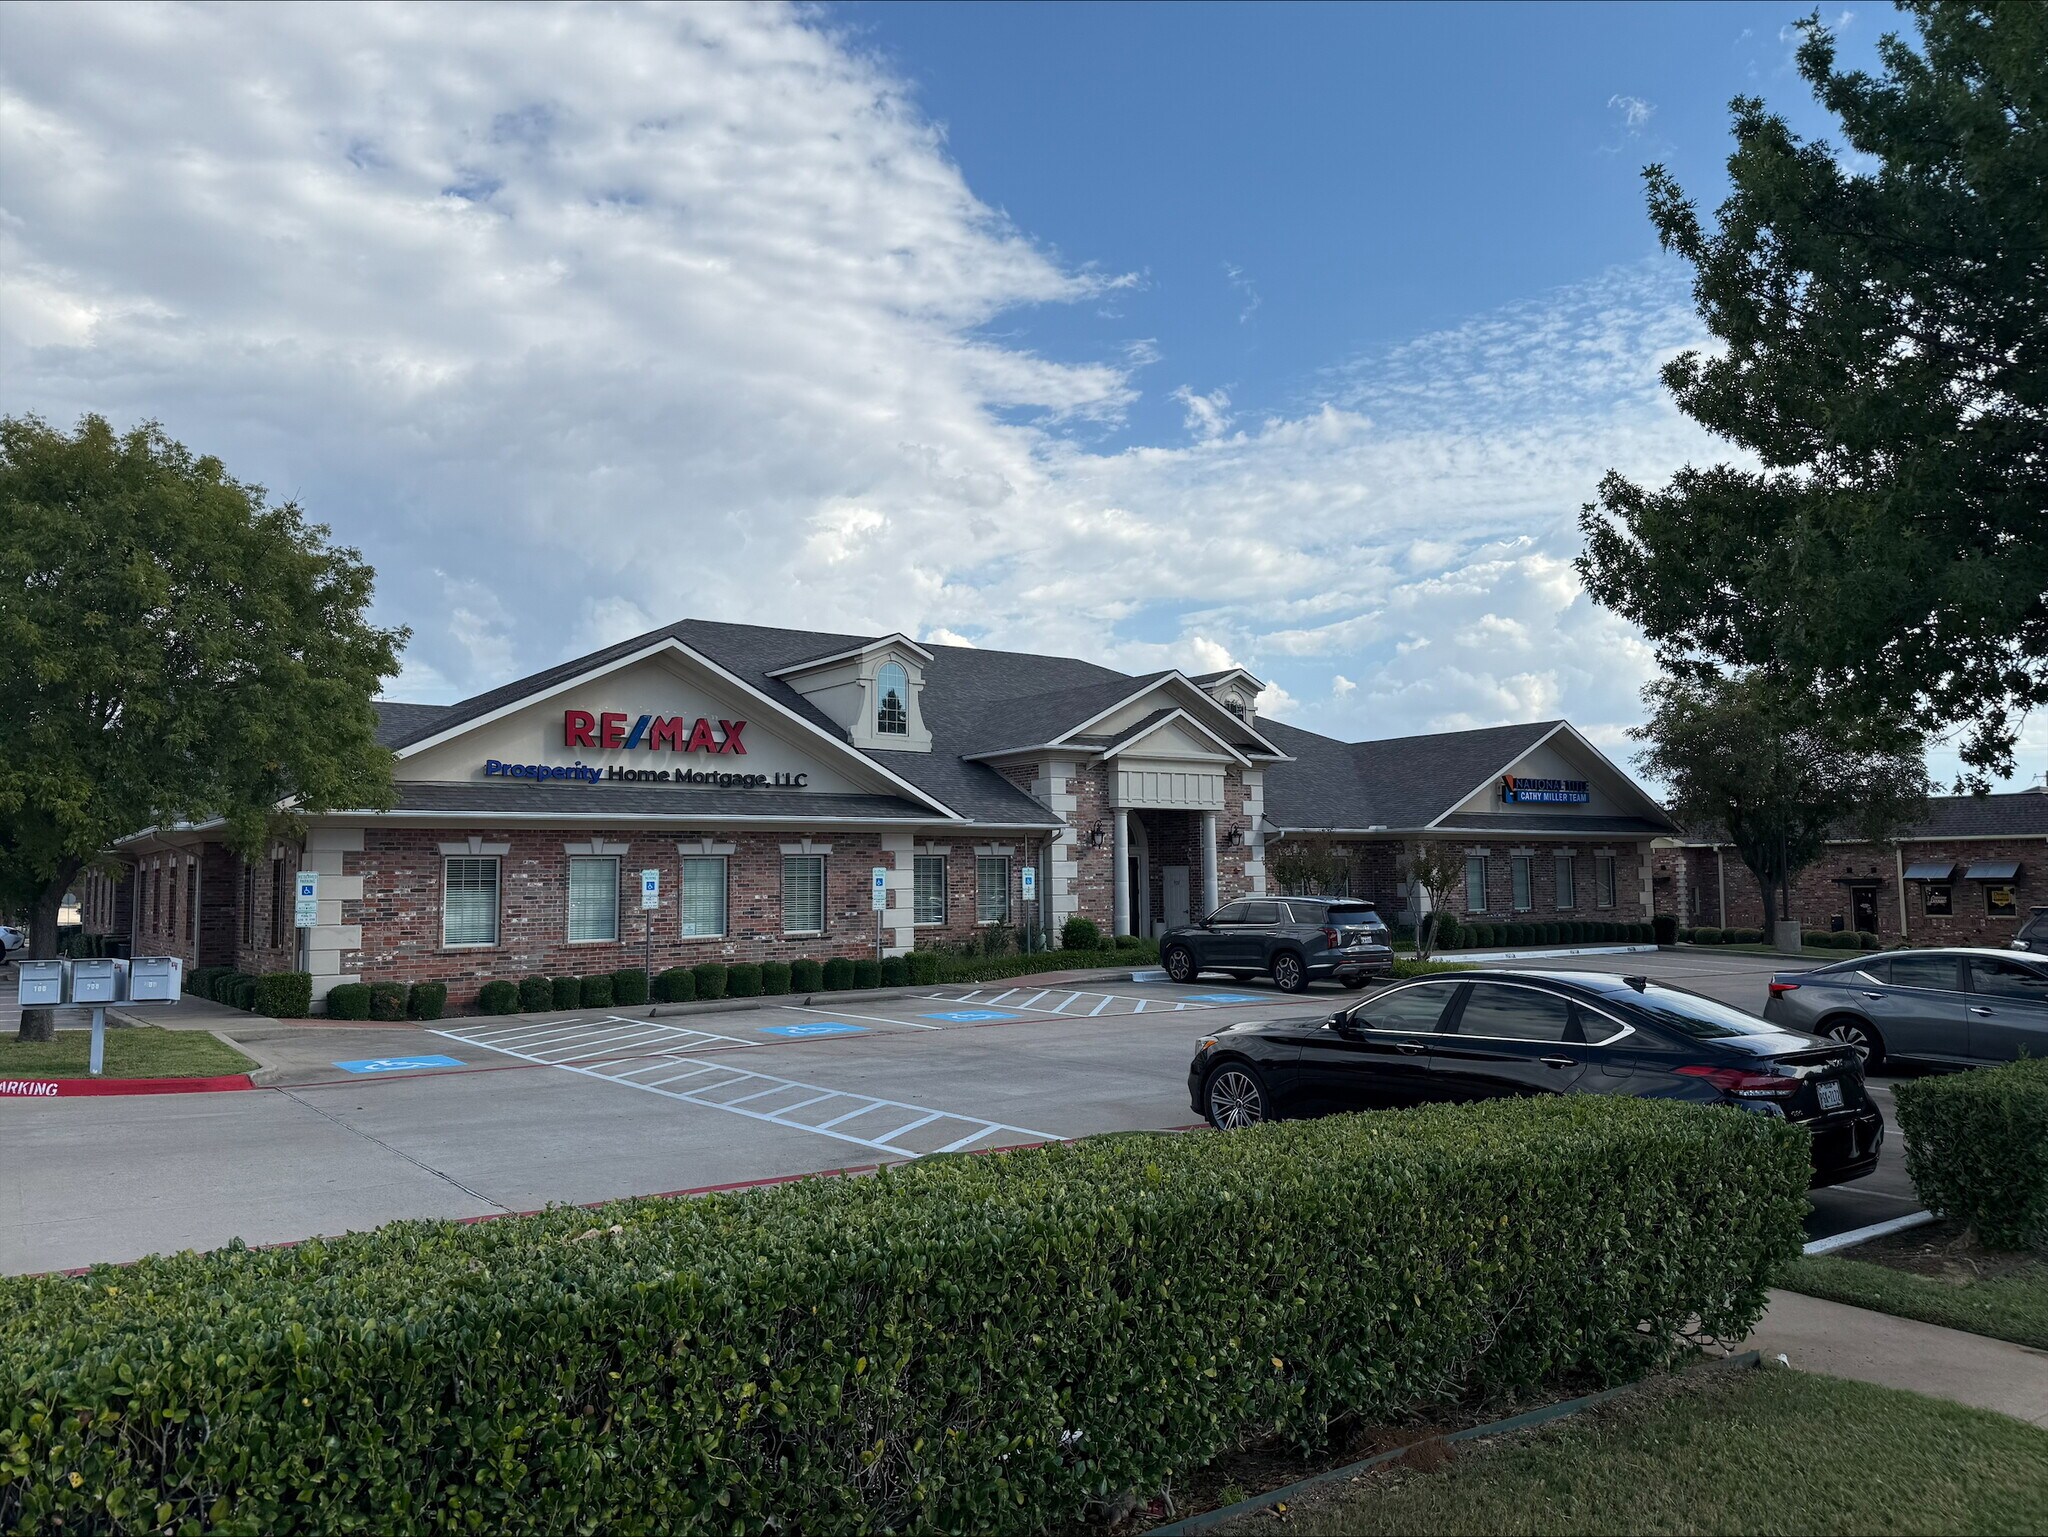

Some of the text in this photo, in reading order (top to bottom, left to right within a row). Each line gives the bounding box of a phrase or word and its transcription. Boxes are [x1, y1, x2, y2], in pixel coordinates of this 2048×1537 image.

[565, 709, 747, 755] RE/MAX
[485, 759, 808, 789] Prosperity Home Mortgage, LLC
[1520, 791, 1587, 802] CATHY MILLER TEAM
[33, 985, 47, 993] 100
